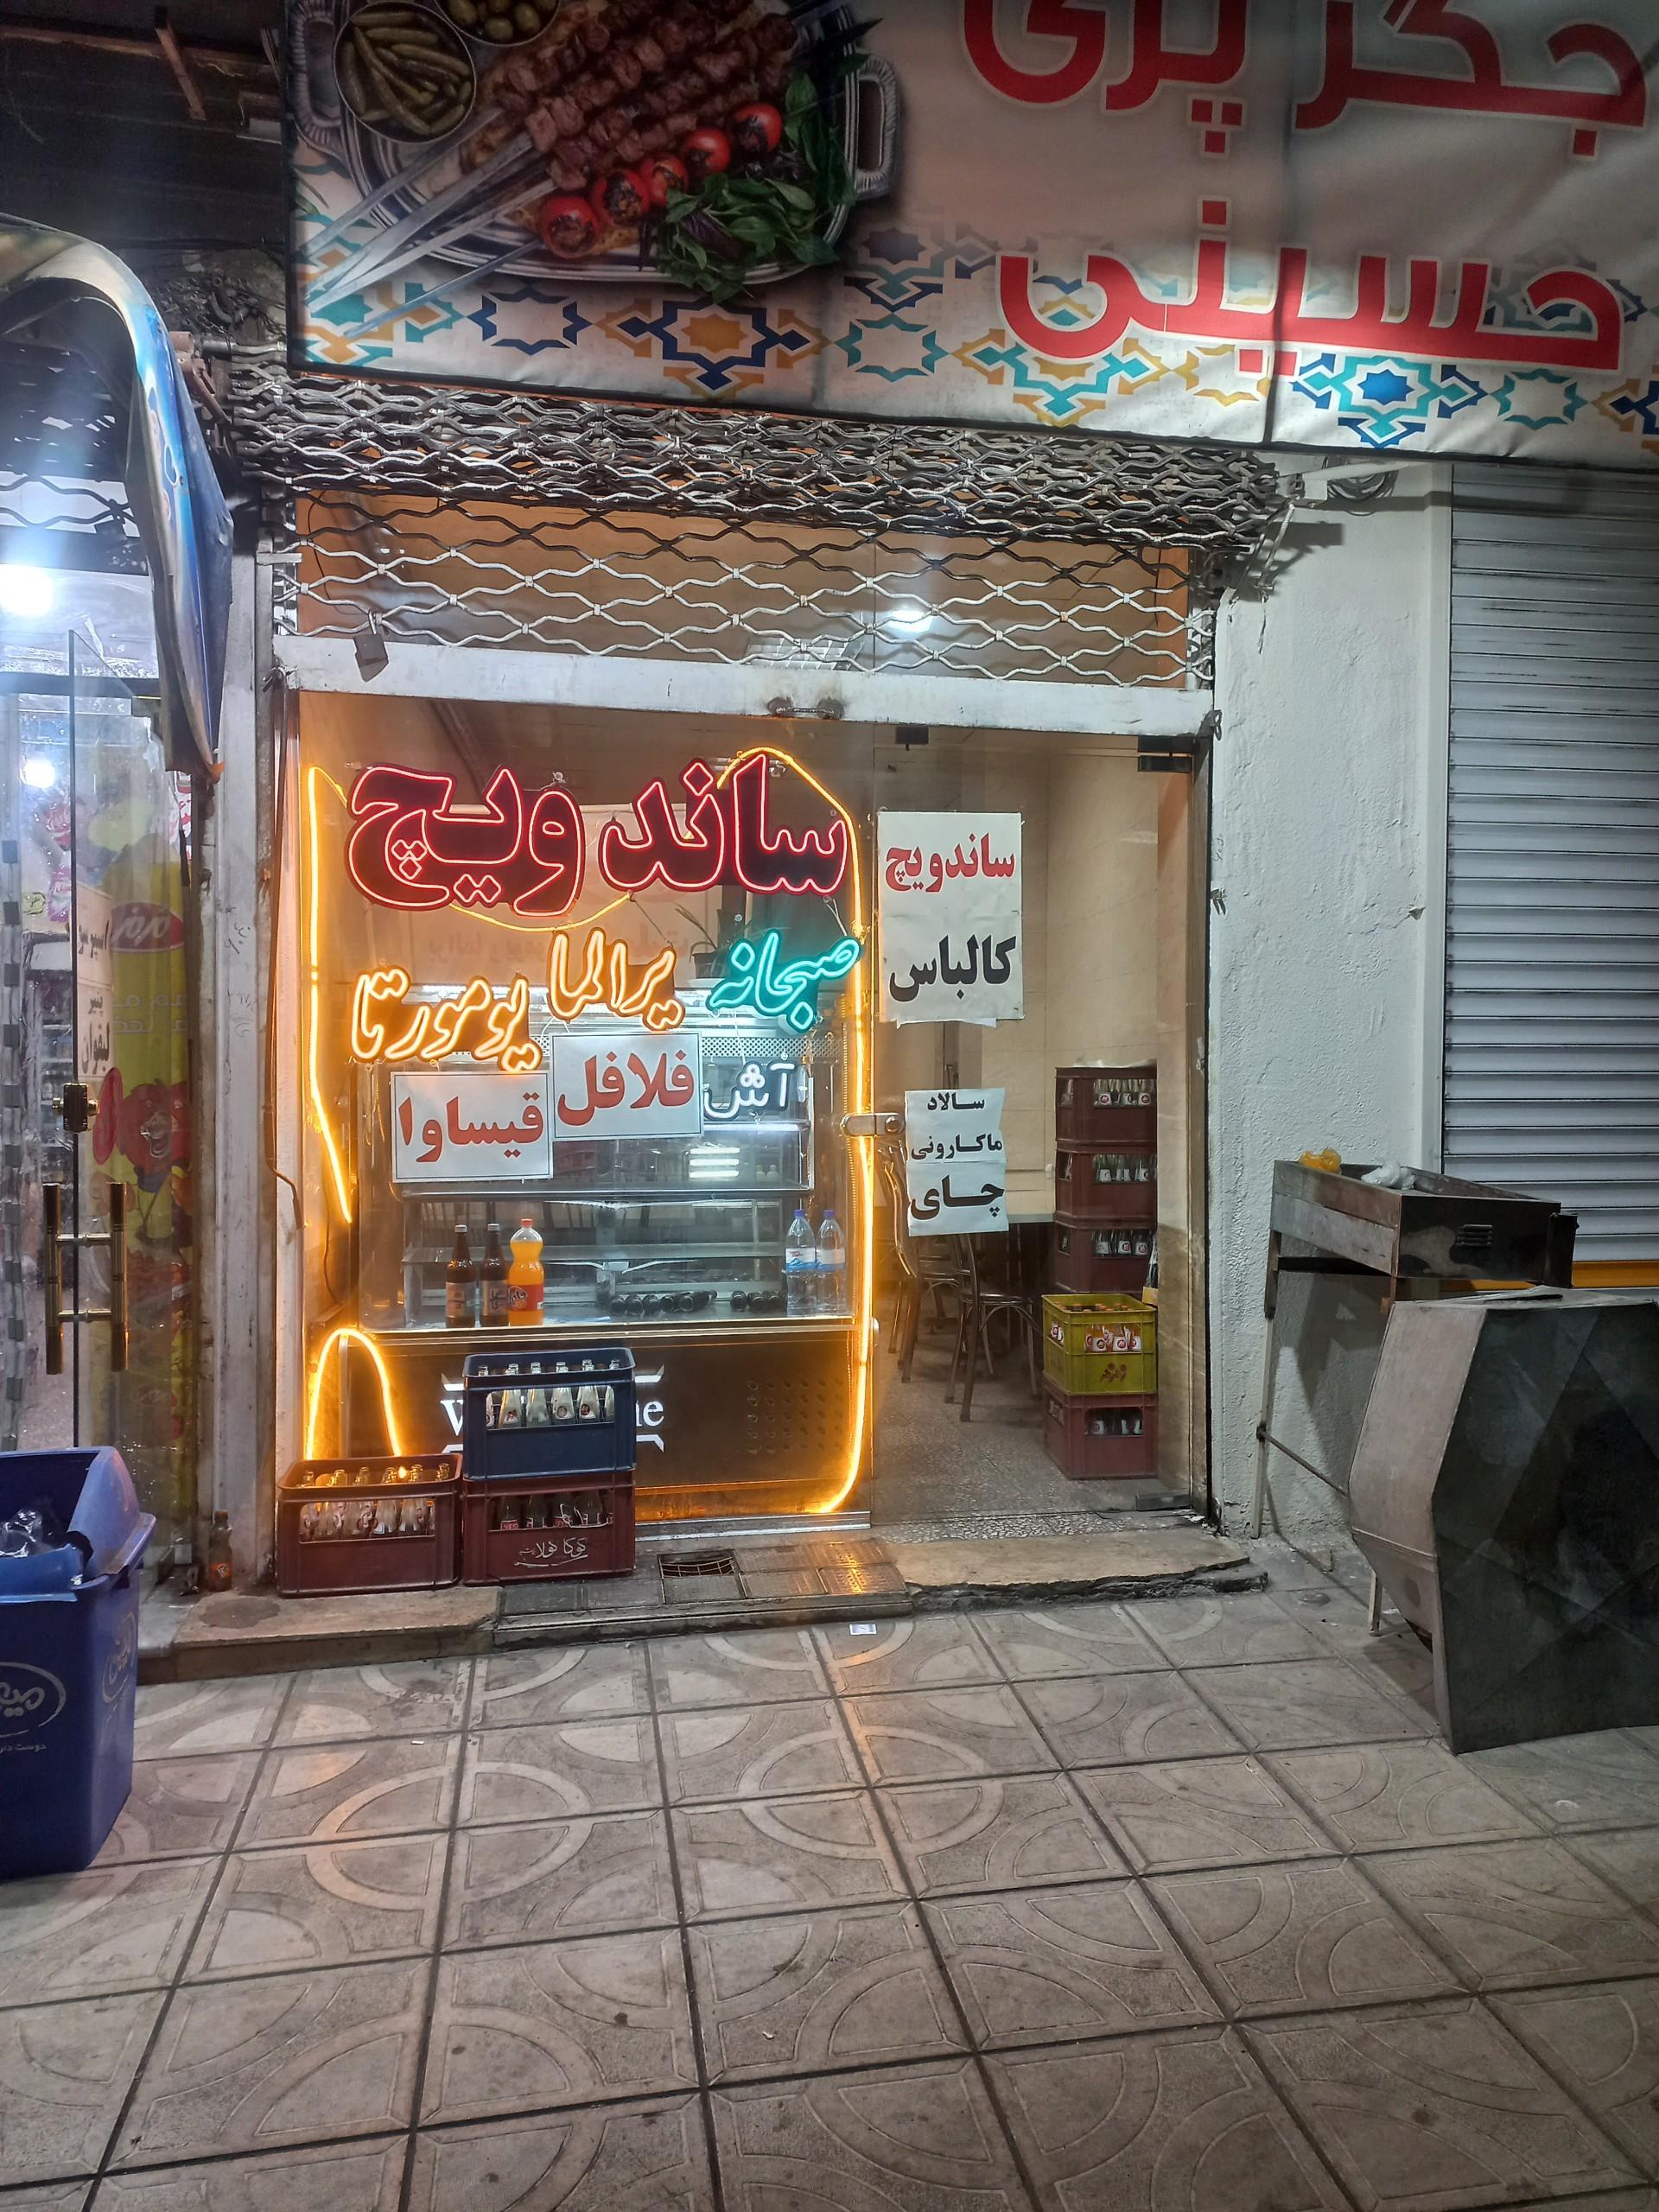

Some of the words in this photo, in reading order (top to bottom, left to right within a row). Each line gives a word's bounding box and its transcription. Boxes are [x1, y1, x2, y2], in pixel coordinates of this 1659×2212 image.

[1000, 199, 1622, 376] حسینی
[349, 753, 848, 916] ساندویچ
[886, 833, 1016, 893] ساندویچ
[709, 929, 861, 1032] صبحانه
[888, 935, 1017, 1002] کالباس
[557, 1049, 695, 1126] فلافل
[702, 1061, 796, 1121] آش
[926, 1091, 985, 1111] سالاد
[397, 1092, 545, 1163] قیساوا
[911, 1134, 1003, 1161] ماکارونی
[909, 1176, 1006, 1220] چای
